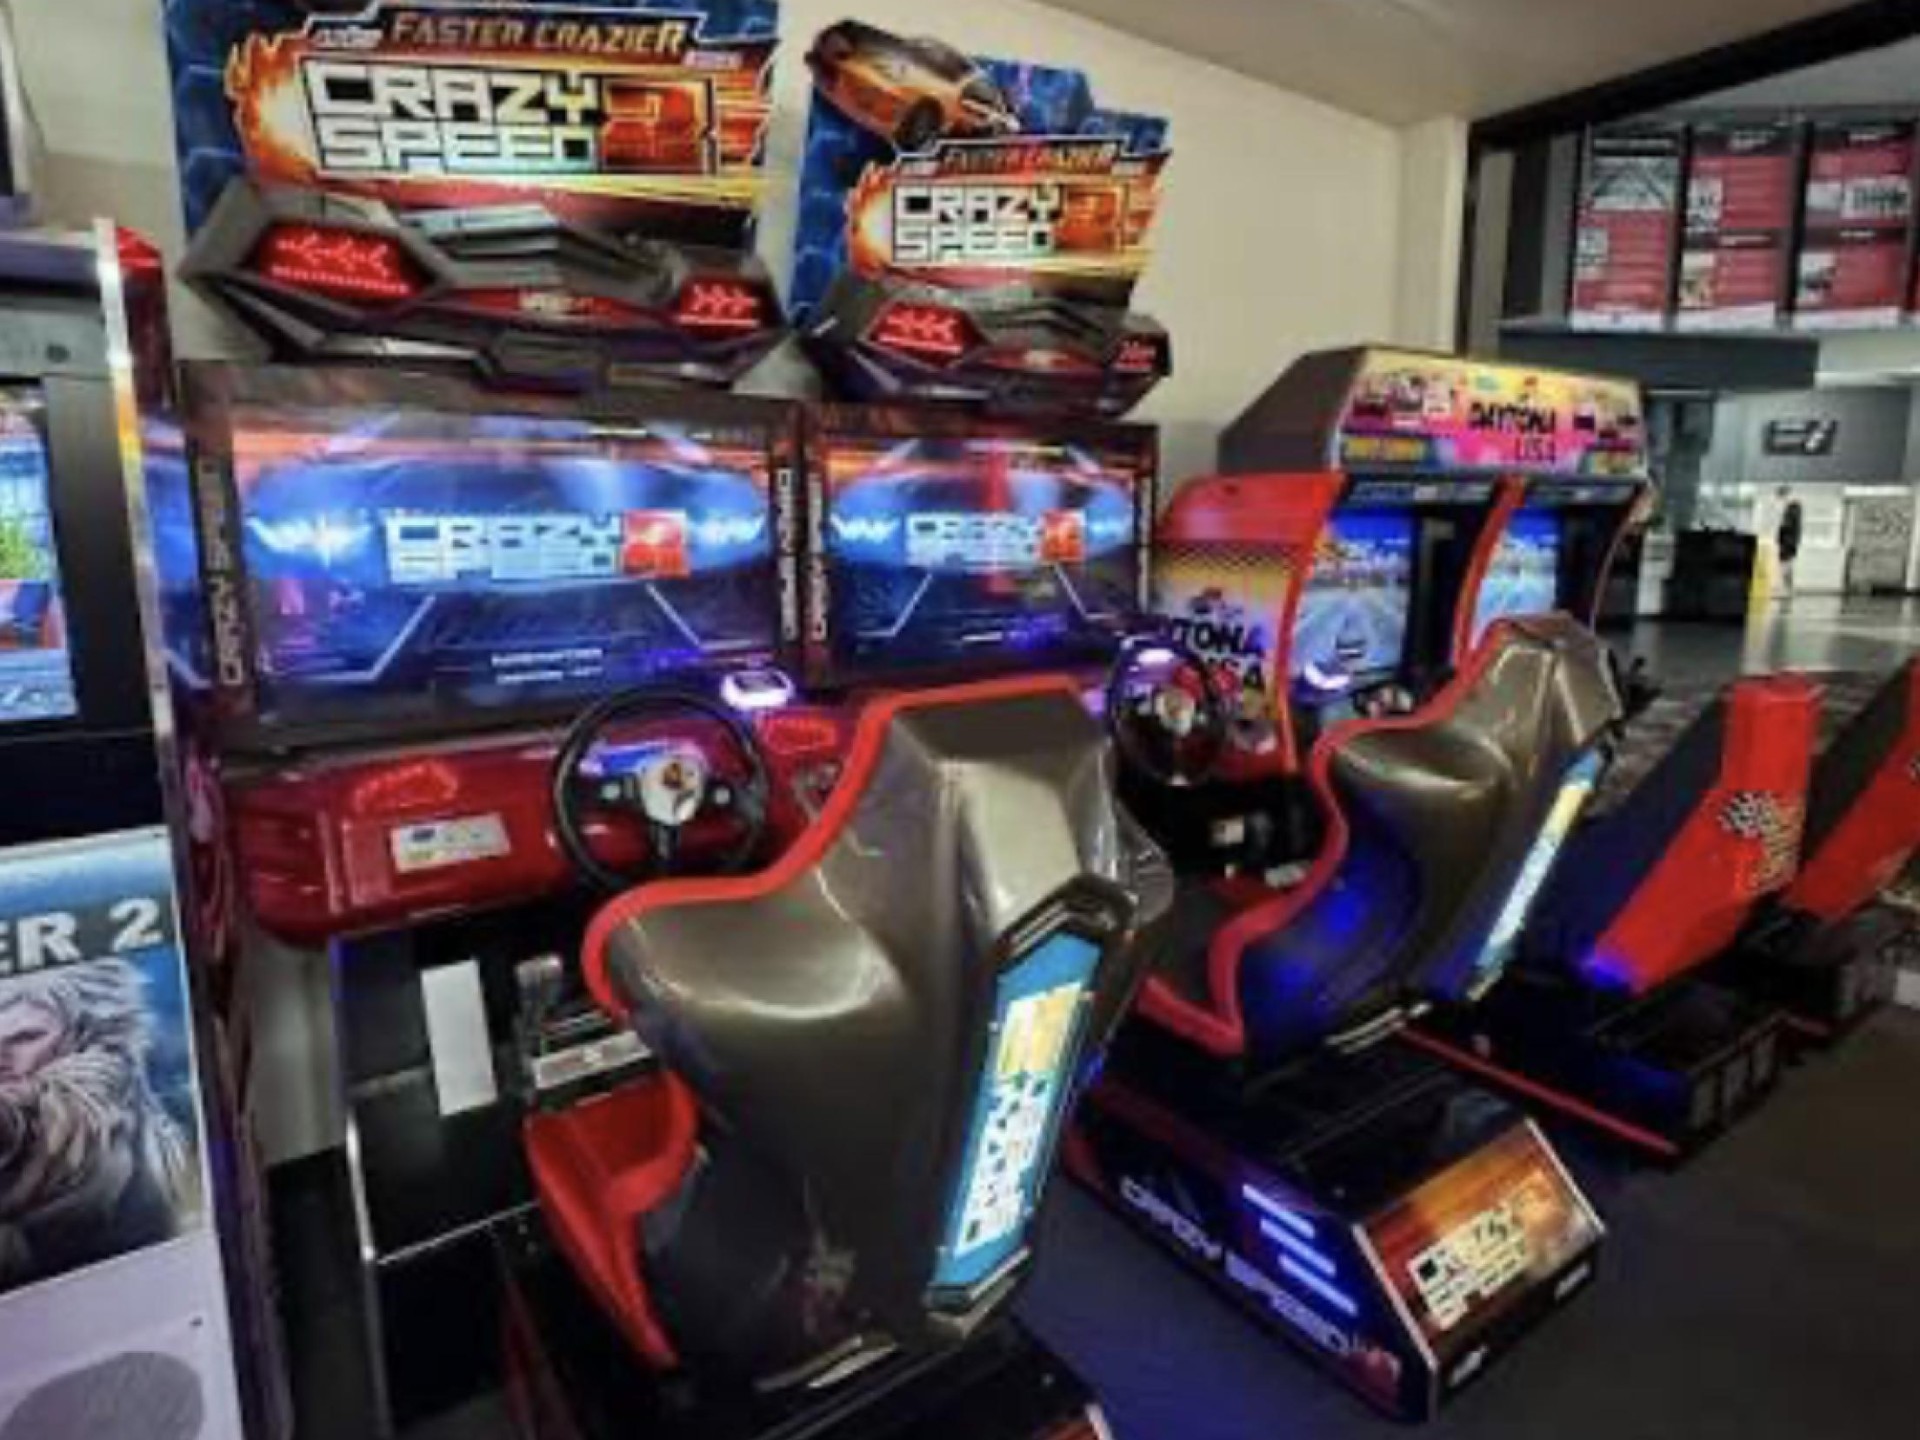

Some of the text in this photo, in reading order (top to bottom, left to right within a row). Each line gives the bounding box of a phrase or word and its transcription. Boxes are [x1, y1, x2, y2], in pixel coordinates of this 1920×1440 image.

[389, 12, 523, 46] FASTER
[533, 18, 686, 54] CRAZIER
[307, 60, 598, 124] CRAZY
[318, 120, 601, 175] SPEED
[893, 184, 1062, 225] CRAZY
[1513, 436, 1558, 463] USA
[385, 513, 622, 550] CRAZY
[0, 896, 164, 973] R 2
